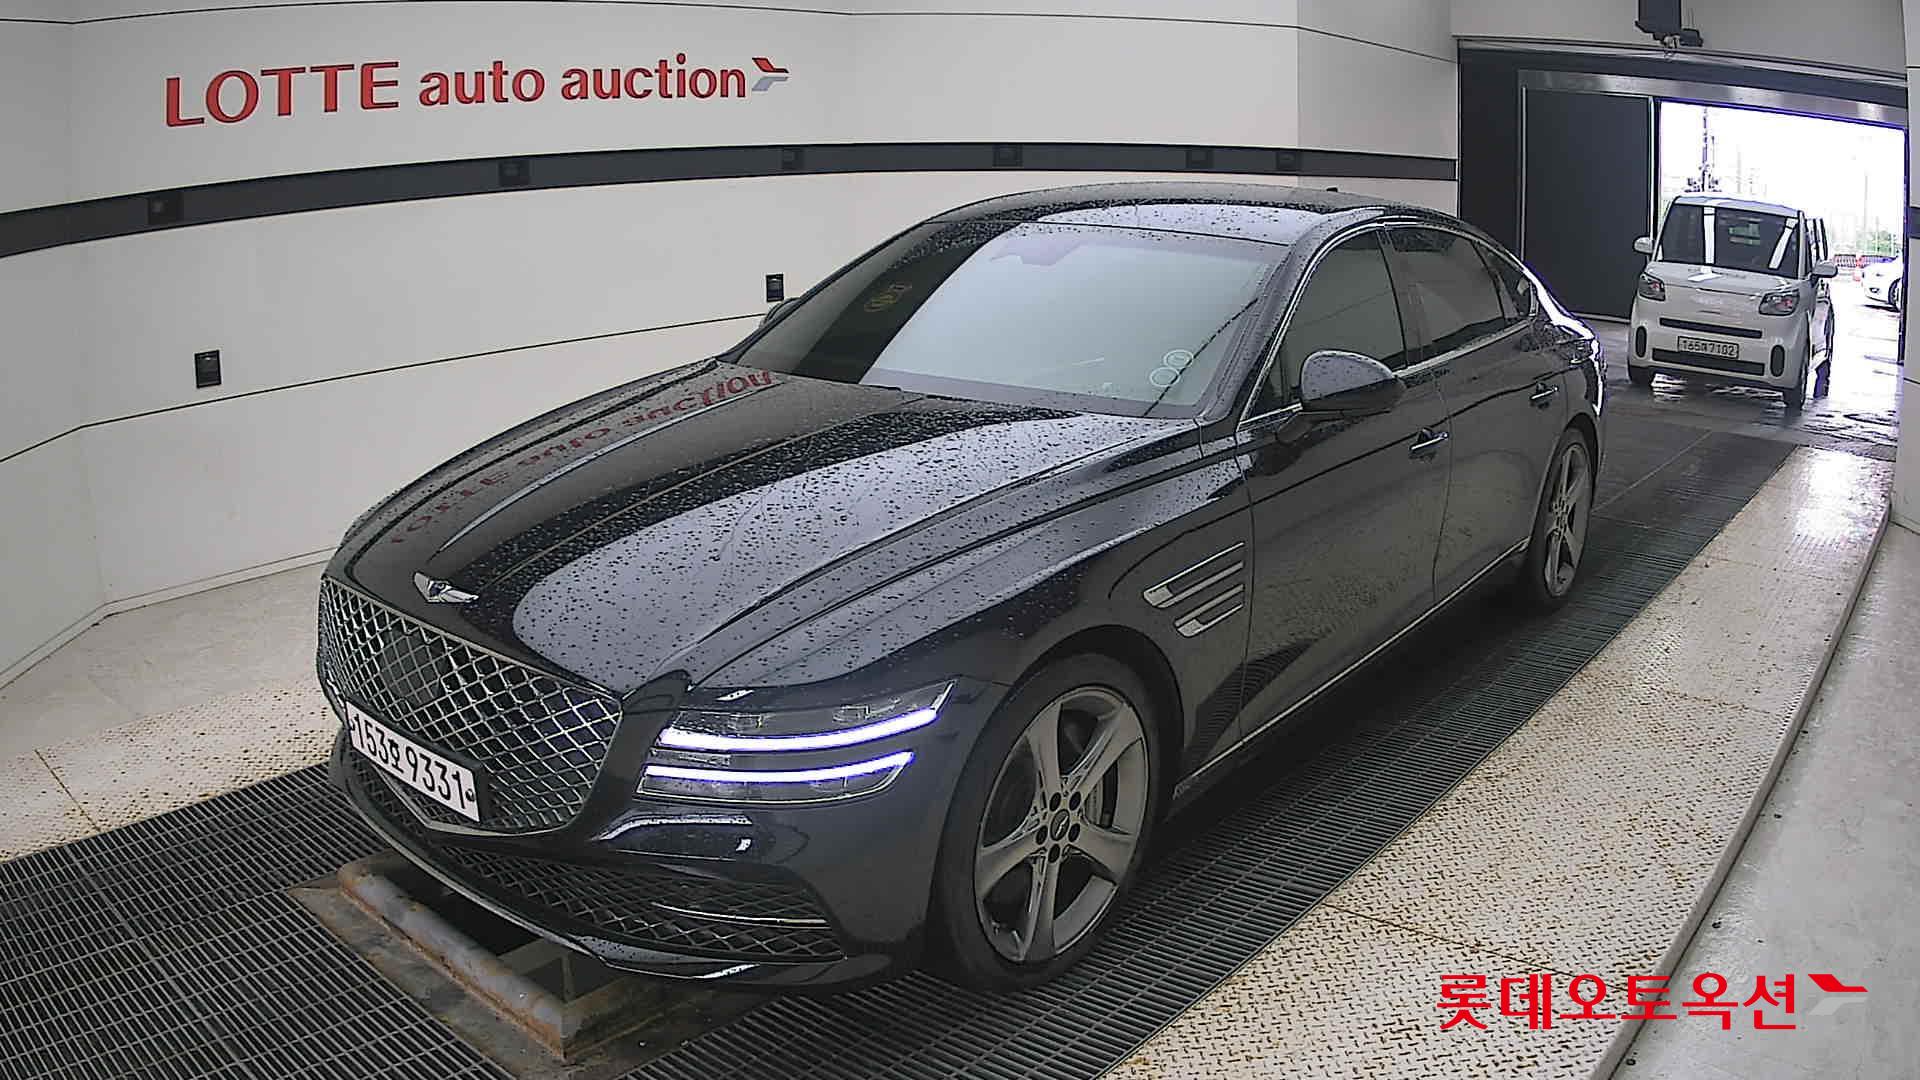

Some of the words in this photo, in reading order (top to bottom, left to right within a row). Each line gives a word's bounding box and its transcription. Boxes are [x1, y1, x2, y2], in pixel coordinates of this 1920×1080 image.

[164, 62, 400, 128] LOTTE
[418, 60, 547, 107] auto
[560, 53, 748, 100] auction
